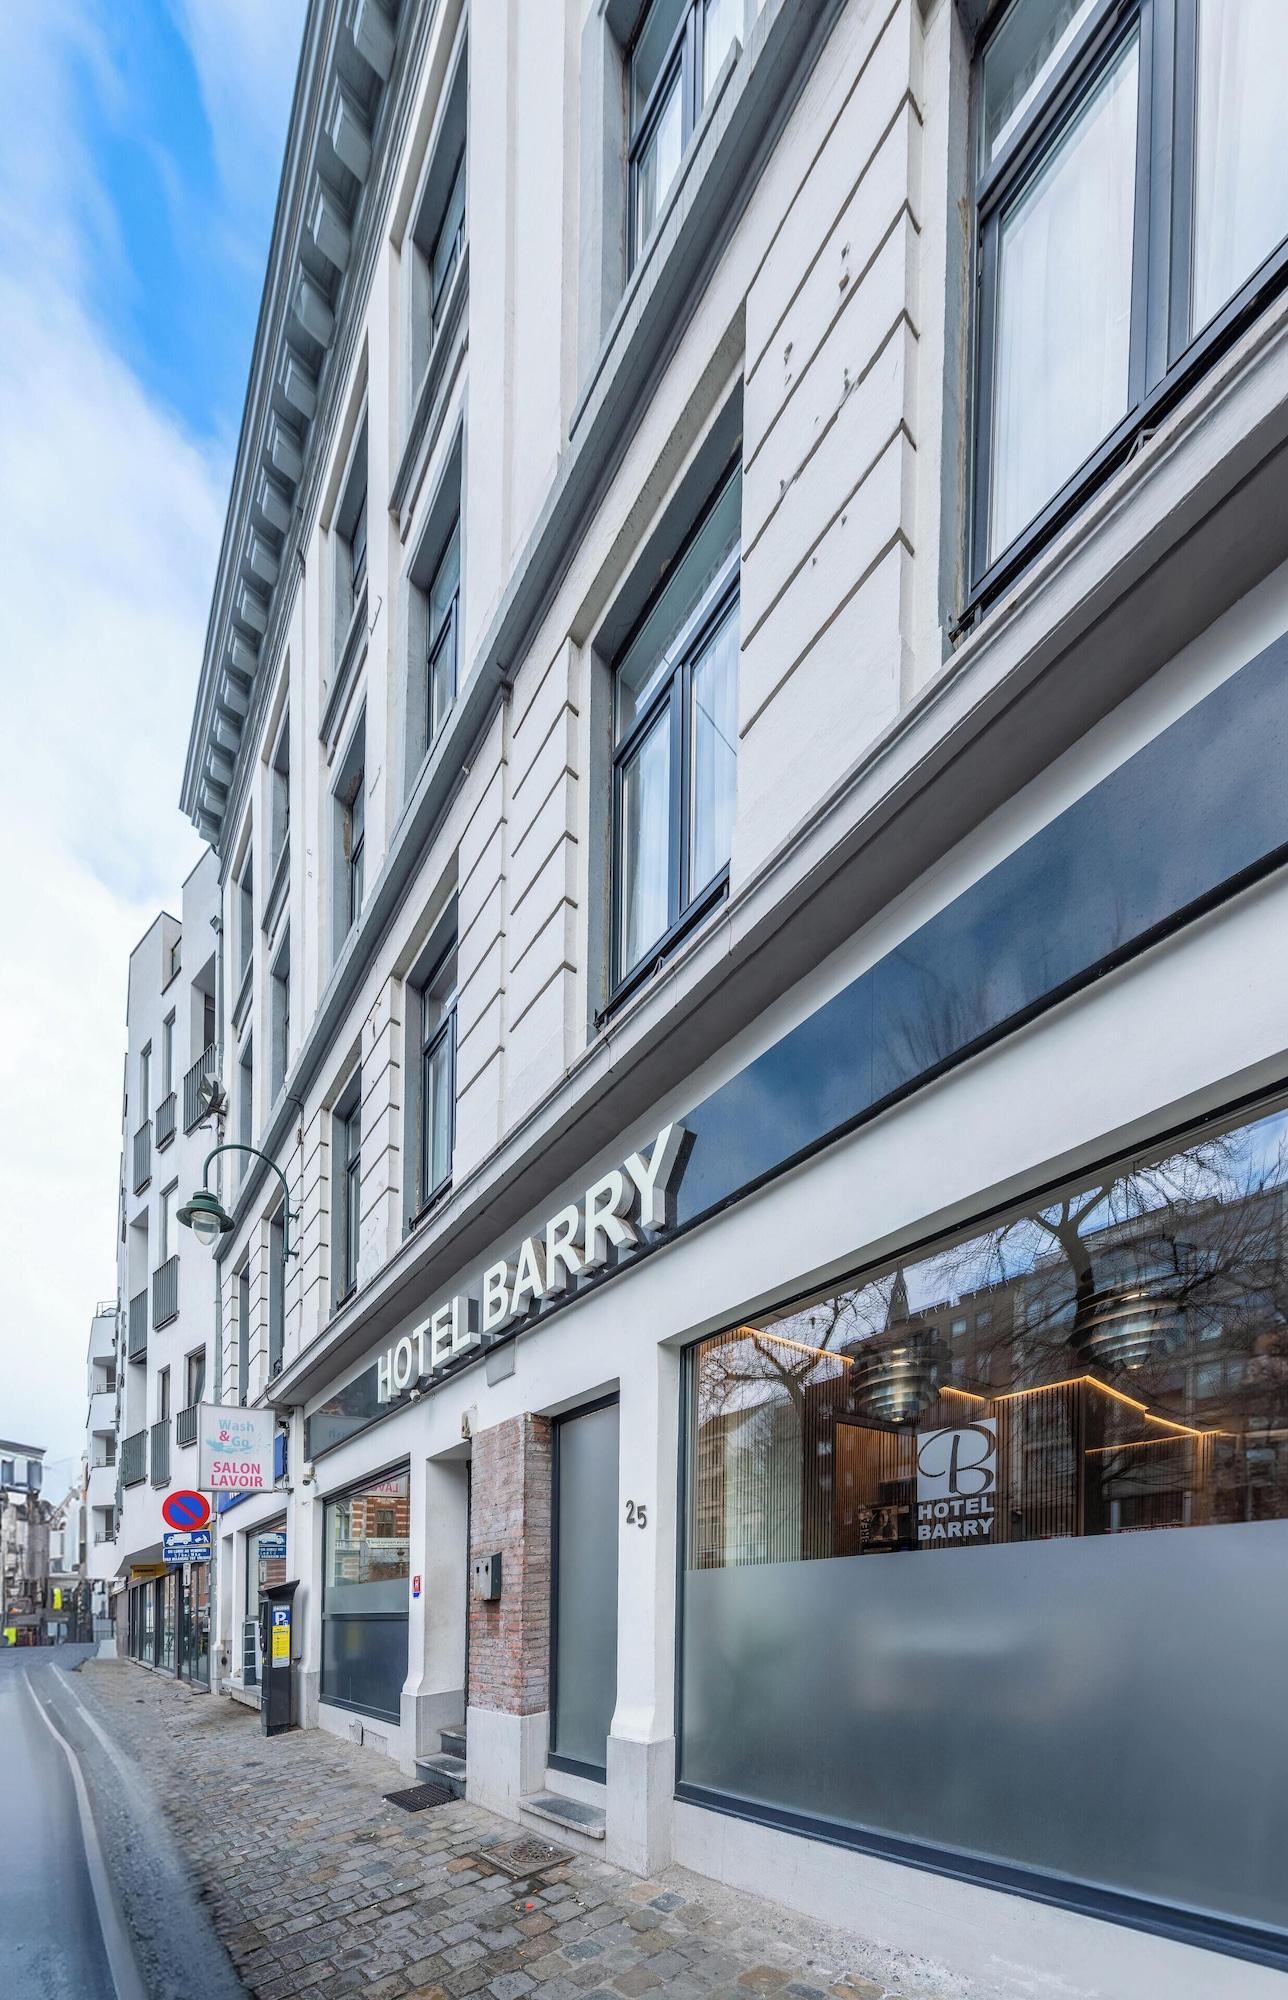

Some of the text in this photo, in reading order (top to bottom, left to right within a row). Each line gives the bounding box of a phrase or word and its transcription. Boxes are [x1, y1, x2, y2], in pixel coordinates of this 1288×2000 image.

[377, 1121, 686, 1404] HOTEL BARRY
[218, 1419, 255, 1432] Wash
[219, 1430, 250, 1447] & Go
[213, 1461, 261, 1475] SALON
[210, 1474, 263, 1487] LAVOIR
[625, 1499, 648, 1530] 25
[918, 1496, 995, 1521] HOTEL
[918, 1517, 995, 1541] BARRY
[275, 1611, 287, 1626] P
